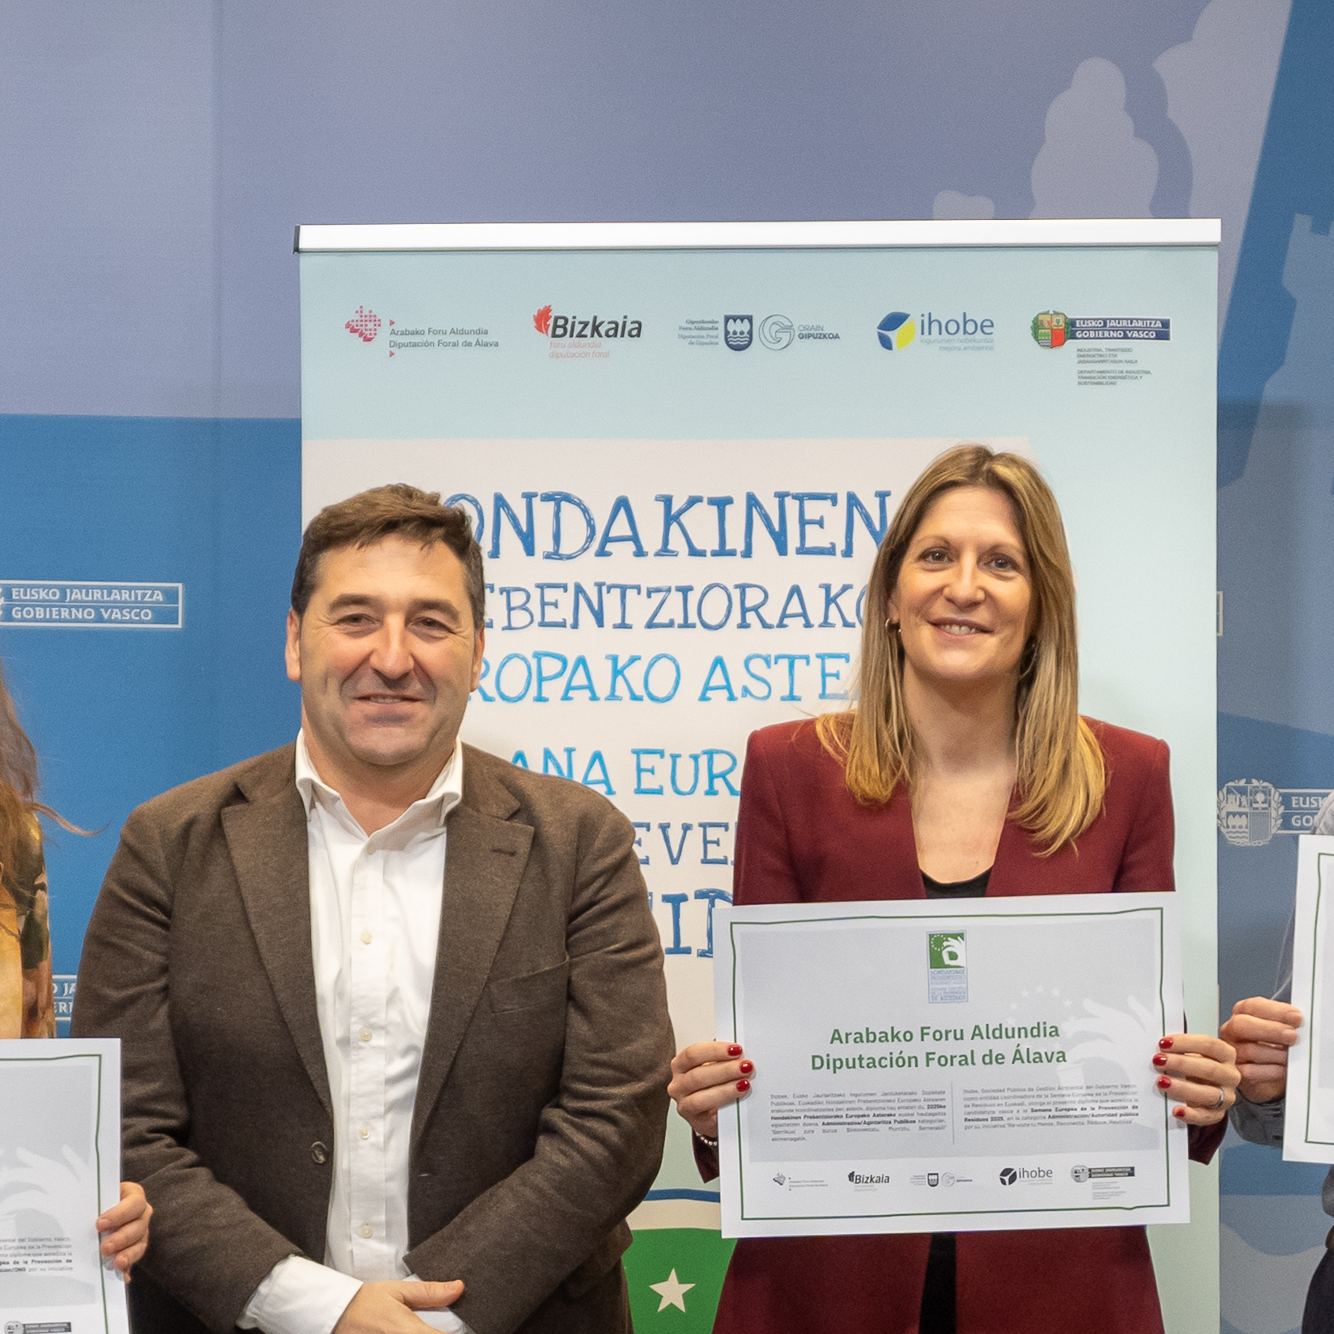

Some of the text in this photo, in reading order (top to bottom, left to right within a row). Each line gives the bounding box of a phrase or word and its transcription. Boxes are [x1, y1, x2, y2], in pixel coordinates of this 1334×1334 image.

[551, 315, 643, 339] Bizkaia
[920, 312, 995, 335] ihobe
[1075, 320, 1162, 328] EUSKO JAURLARITZA
[389, 327, 489, 336] Arabako Foru Aldundia
[798, 332, 840, 340] GIPUZKOA
[389, 338, 499, 349] Diputación Foral de Álava
[443, 490, 892, 561] ONDAKINEN
[11, 588, 163, 603] EUSKO JAURLARITZA
[11, 606, 152, 621] GOBIERNO VASCO
[829, 1022, 1060, 1045] Arabako Foru Aldundia
[811, 1043, 1067, 1074] Diputación Foral de Álava
[855, 1173, 890, 1185] Bizkaia
[1018, 1166, 1054, 1180] ihobe
